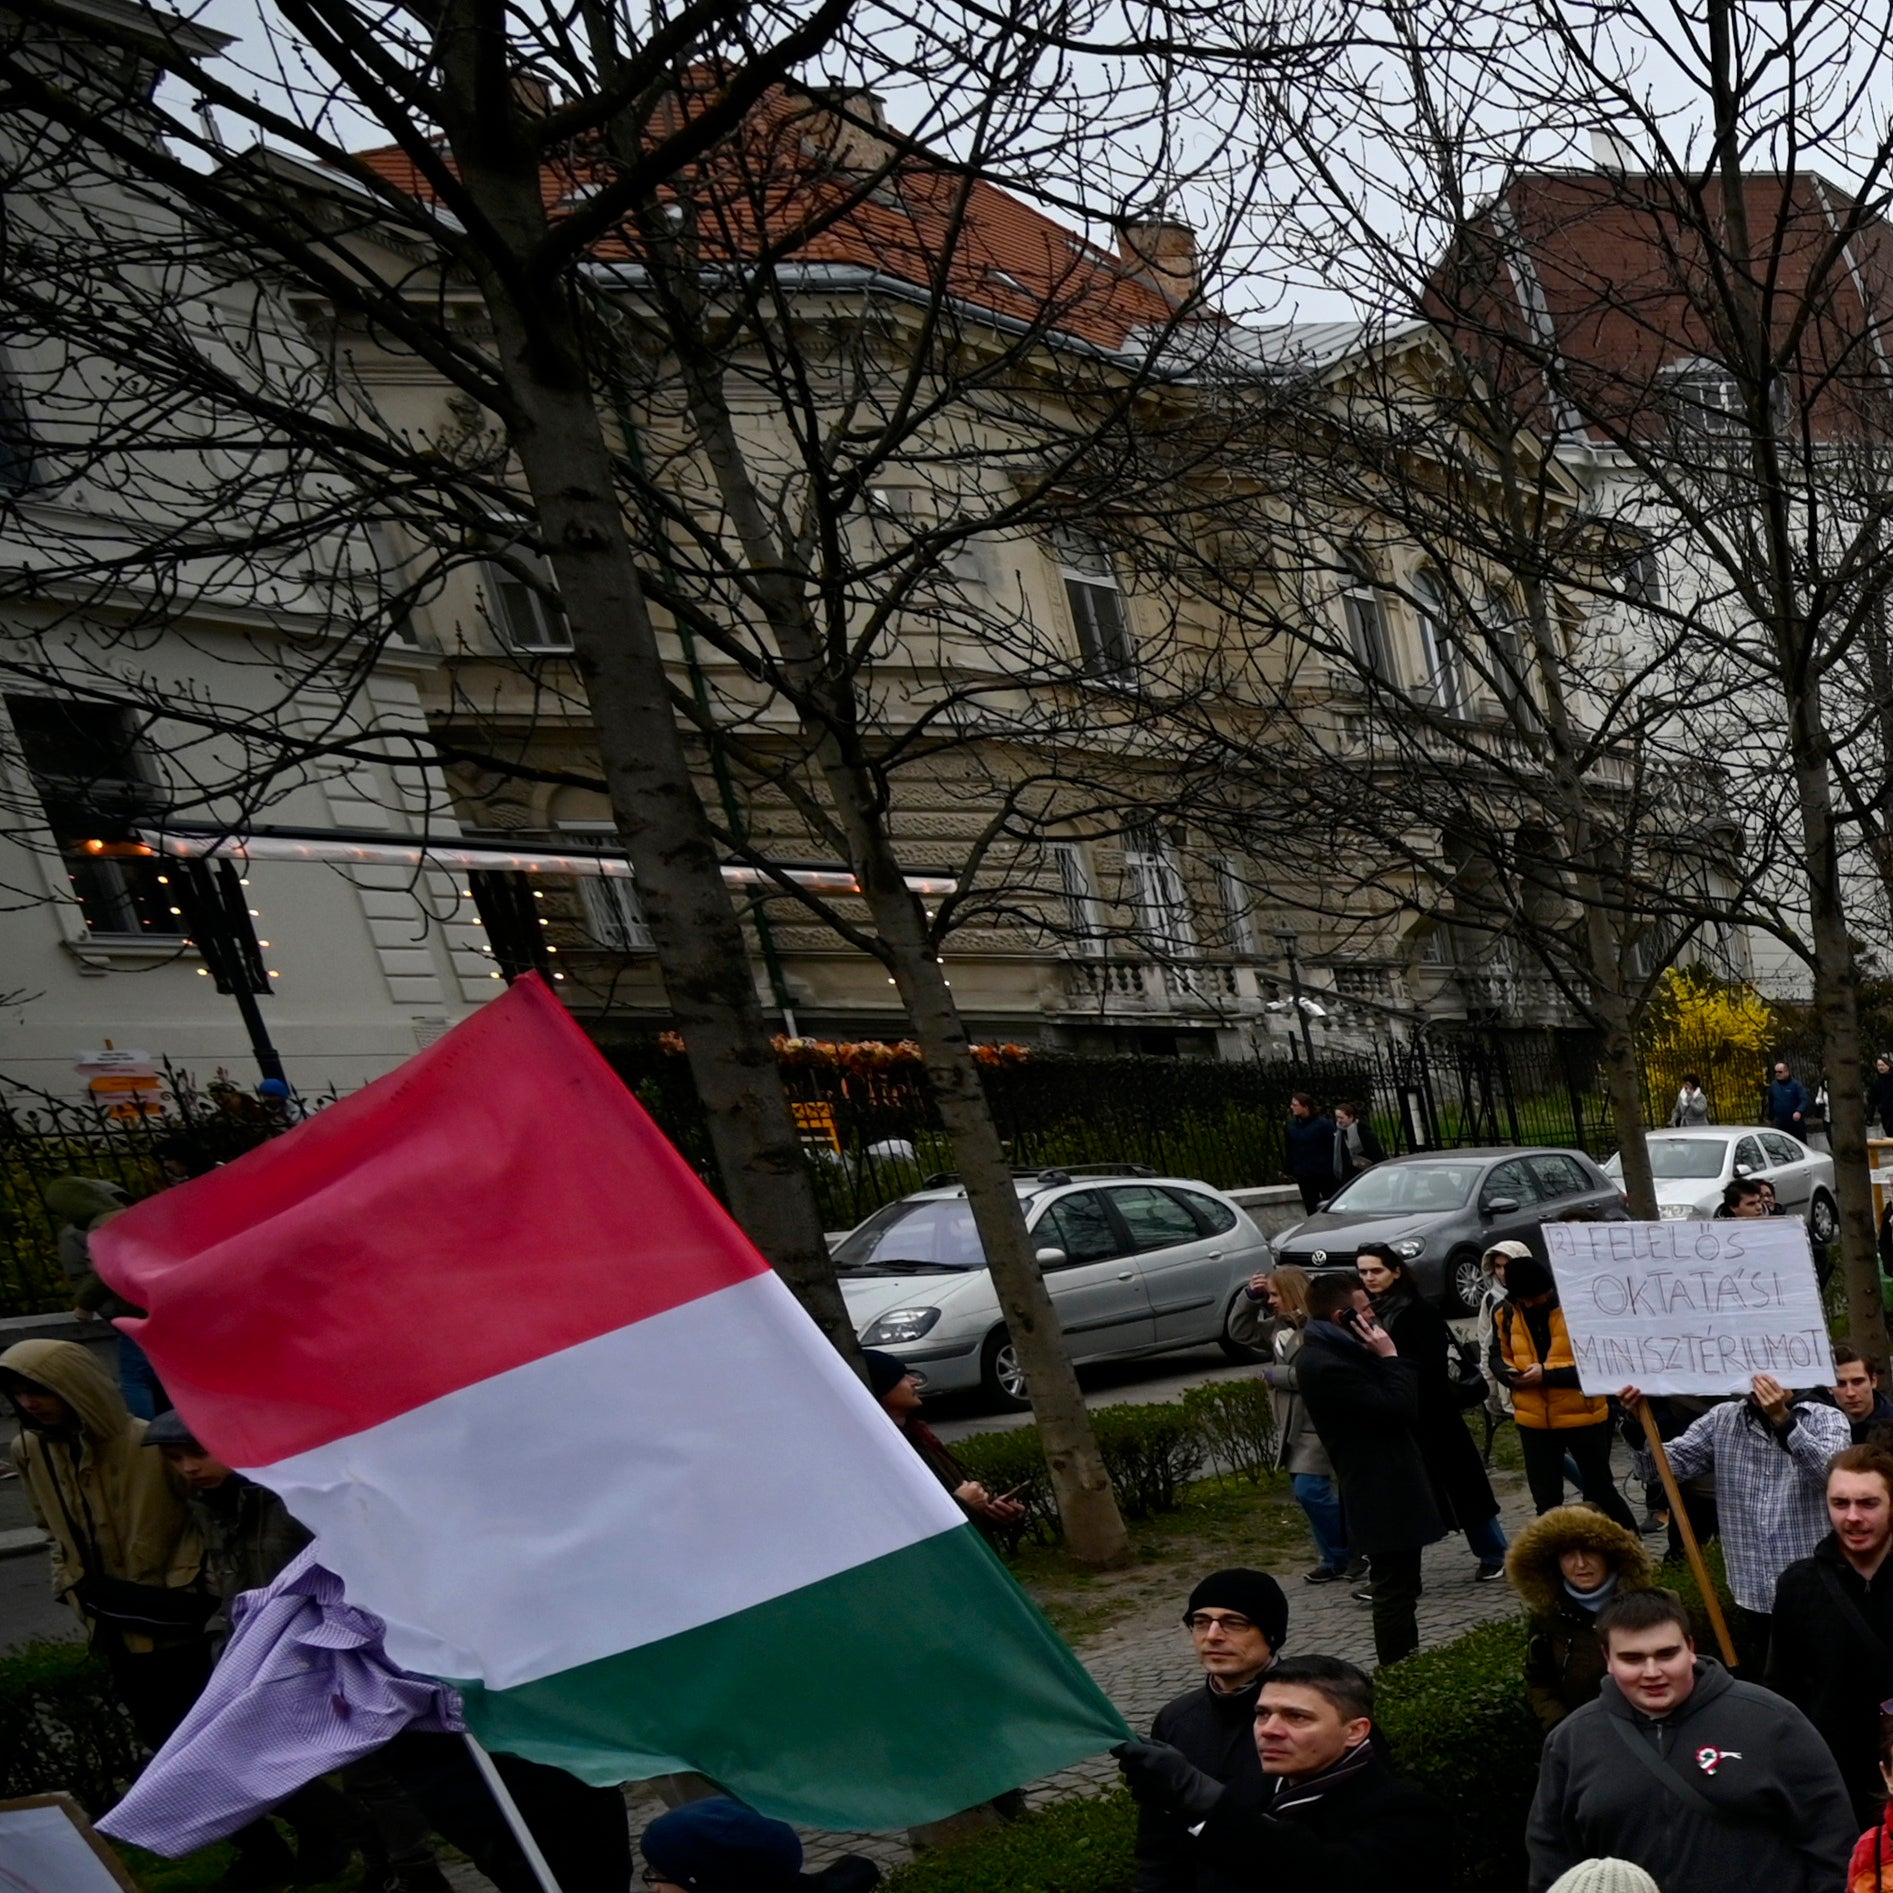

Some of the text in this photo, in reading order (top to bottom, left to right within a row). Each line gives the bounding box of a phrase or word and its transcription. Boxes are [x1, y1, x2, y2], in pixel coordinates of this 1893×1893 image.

[1588, 1221, 1746, 1262] FELELŐS
[1590, 1267, 1785, 1317] OKTATÁSI
[1572, 1324, 1824, 1376] MINISZTÉRIUMOT
